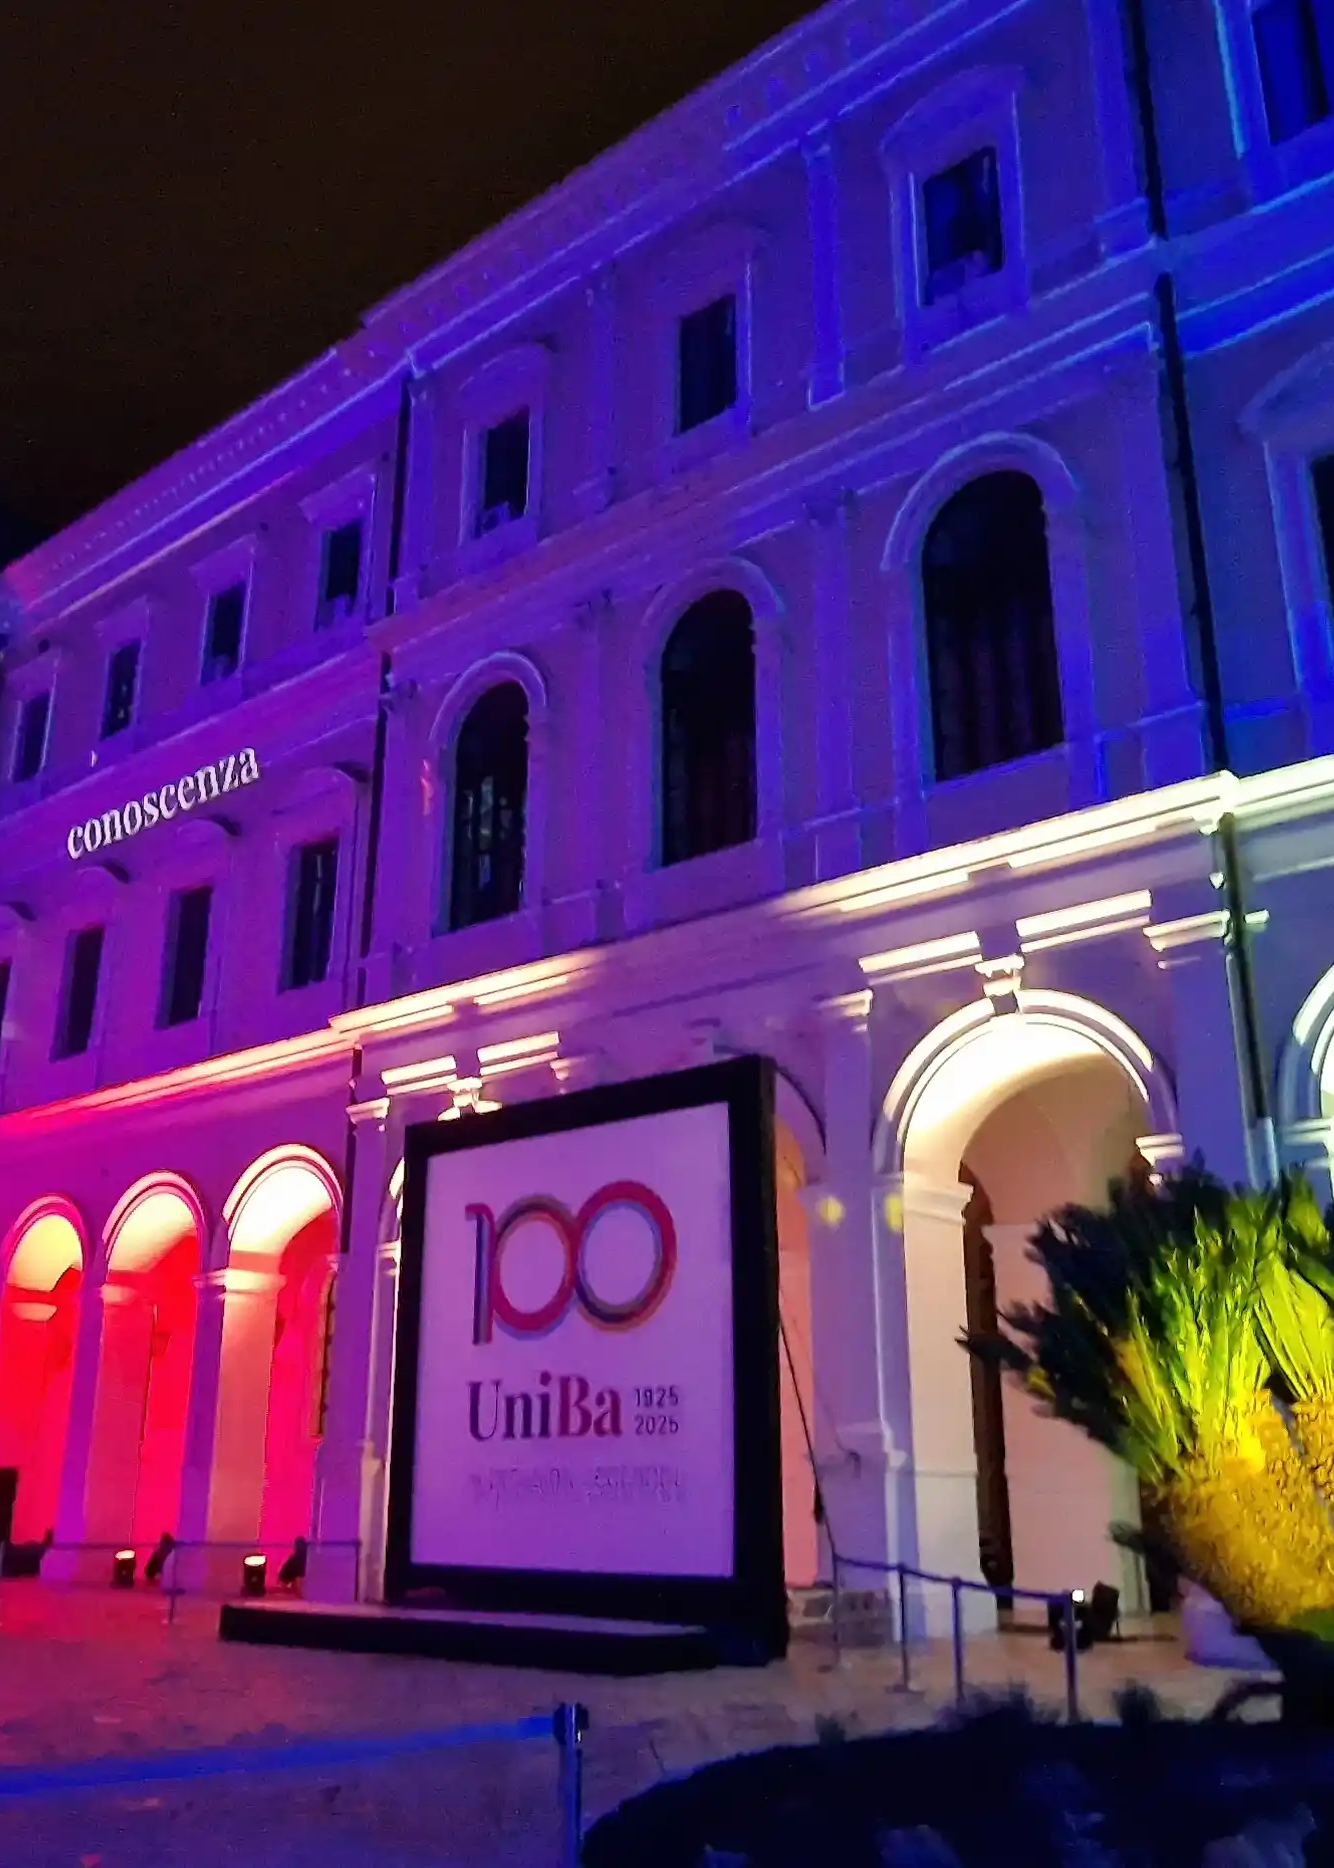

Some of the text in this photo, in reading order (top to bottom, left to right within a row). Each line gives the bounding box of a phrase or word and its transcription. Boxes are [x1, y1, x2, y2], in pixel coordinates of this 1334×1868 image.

[67, 747, 259, 860] conoscenza
[465, 1179, 678, 1346] 100
[467, 1370, 679, 1442] UniBa 1925
